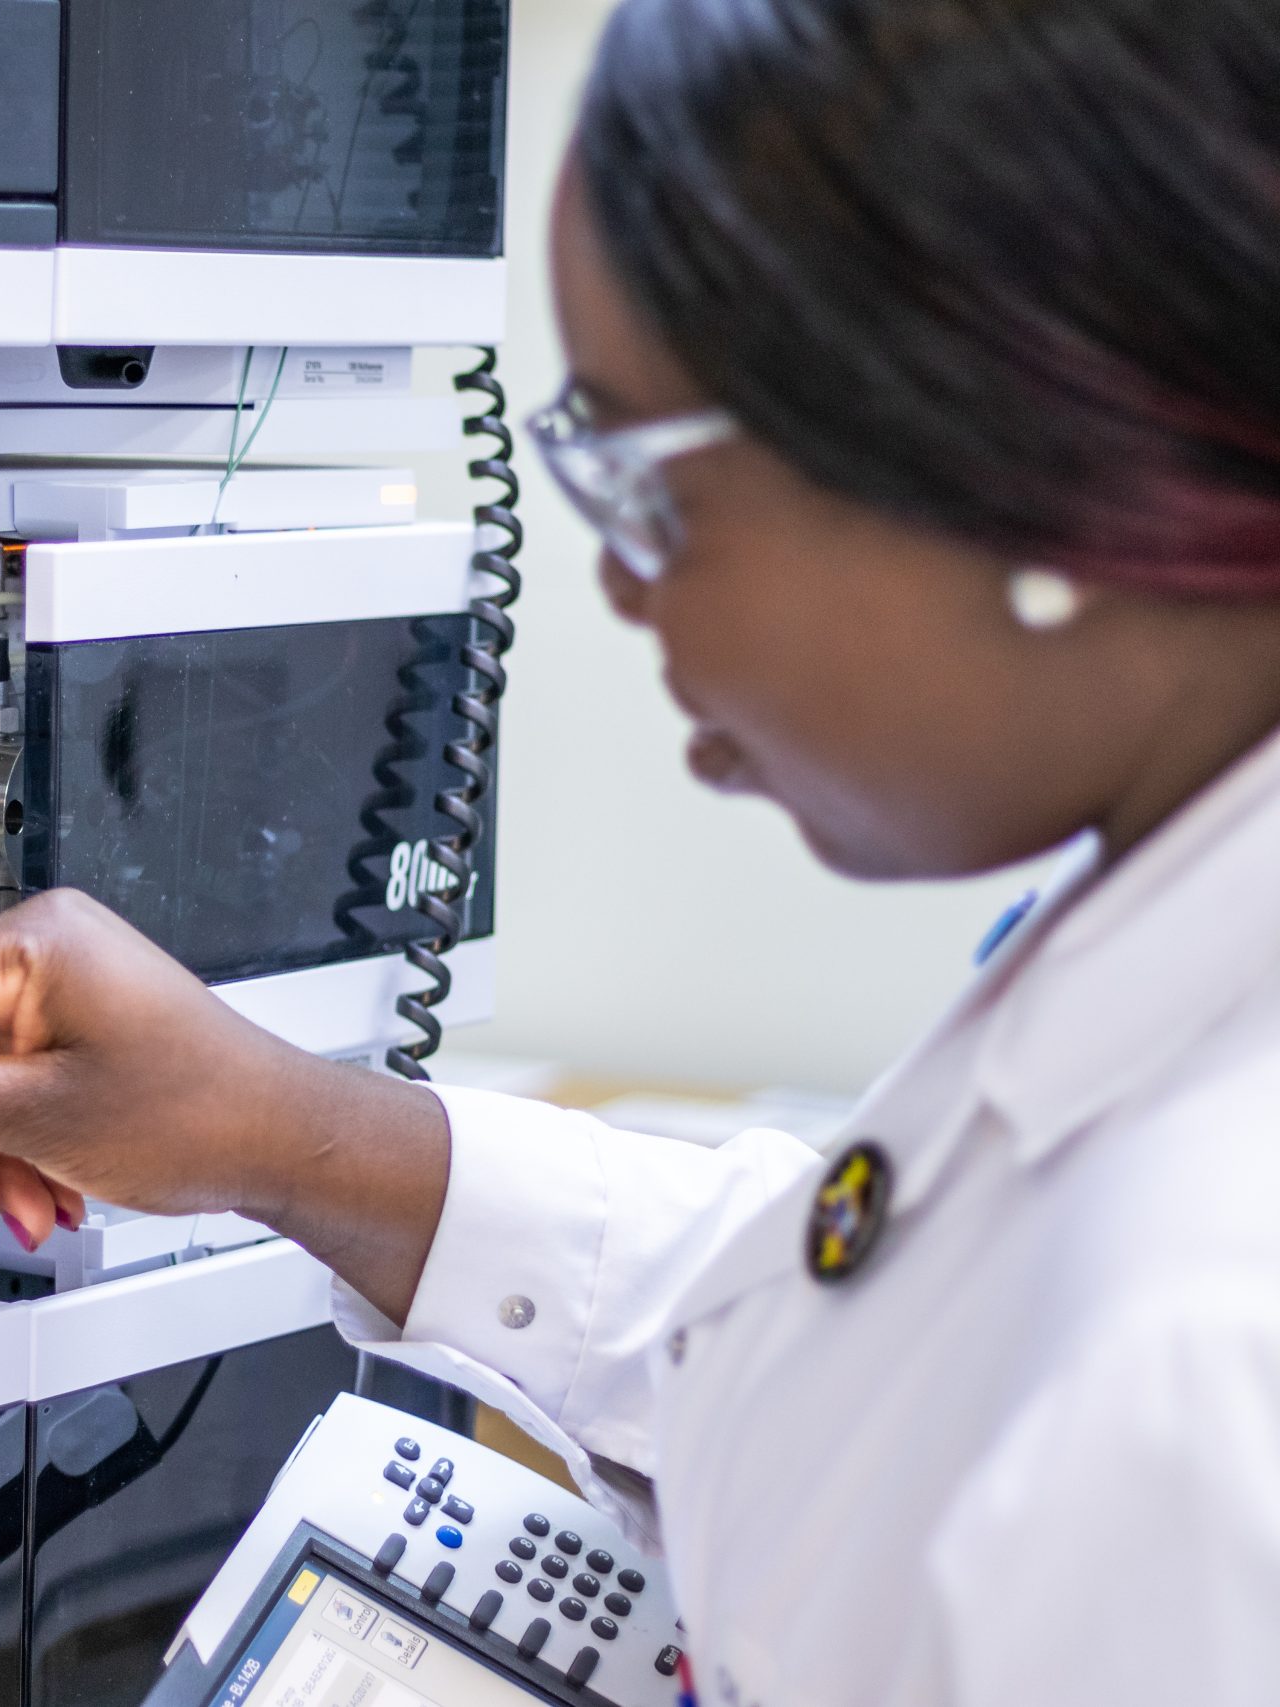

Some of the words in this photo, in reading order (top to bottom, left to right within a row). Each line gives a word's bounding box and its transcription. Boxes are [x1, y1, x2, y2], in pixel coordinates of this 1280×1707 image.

[534, 1514, 546, 1525] 9
[566, 1532, 578, 1542] 6
[520, 1538, 533, 1549] 8
[552, 1556, 565, 1567] 5
[598, 1551, 610, 1561] 3
[506, 1561, 519, 1572] 7
[584, 1574, 597, 1585] 2
[538, 1580, 551, 1591] 4
[570, 1599, 583, 1608] 1
[349, 1605, 373, 1635] Control
[602, 1618, 615, 1628] 0
[398, 1636, 421, 1665] Details
[229, 1658, 261, 1697] BL142B
